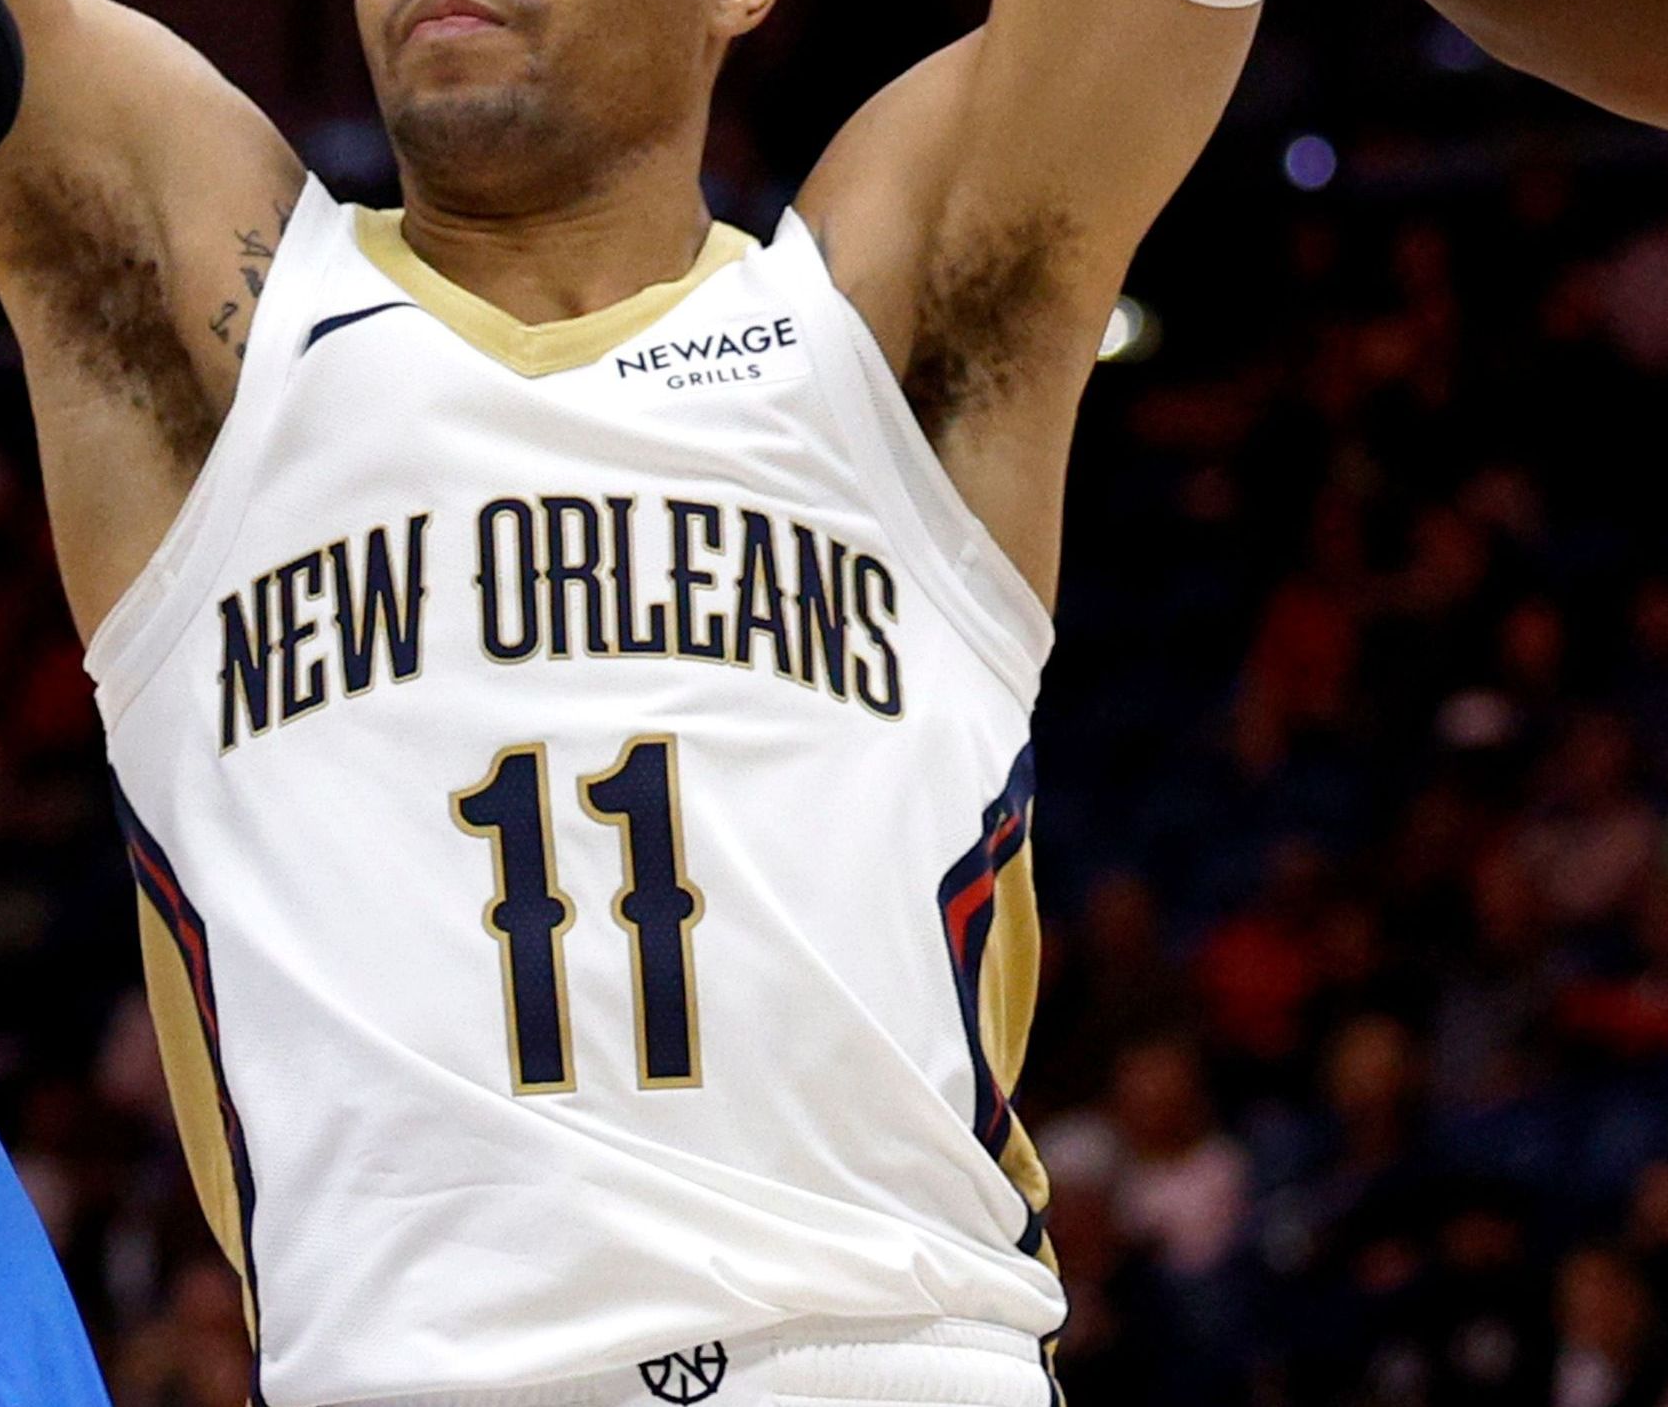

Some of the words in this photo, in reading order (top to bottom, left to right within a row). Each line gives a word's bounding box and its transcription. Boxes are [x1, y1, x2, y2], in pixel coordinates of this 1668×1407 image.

[666, 364, 762, 390] GRILLS
[218, 510, 432, 758] NEW
[474, 494, 905, 723] ORLEANS
[448, 732, 705, 1096] 11
